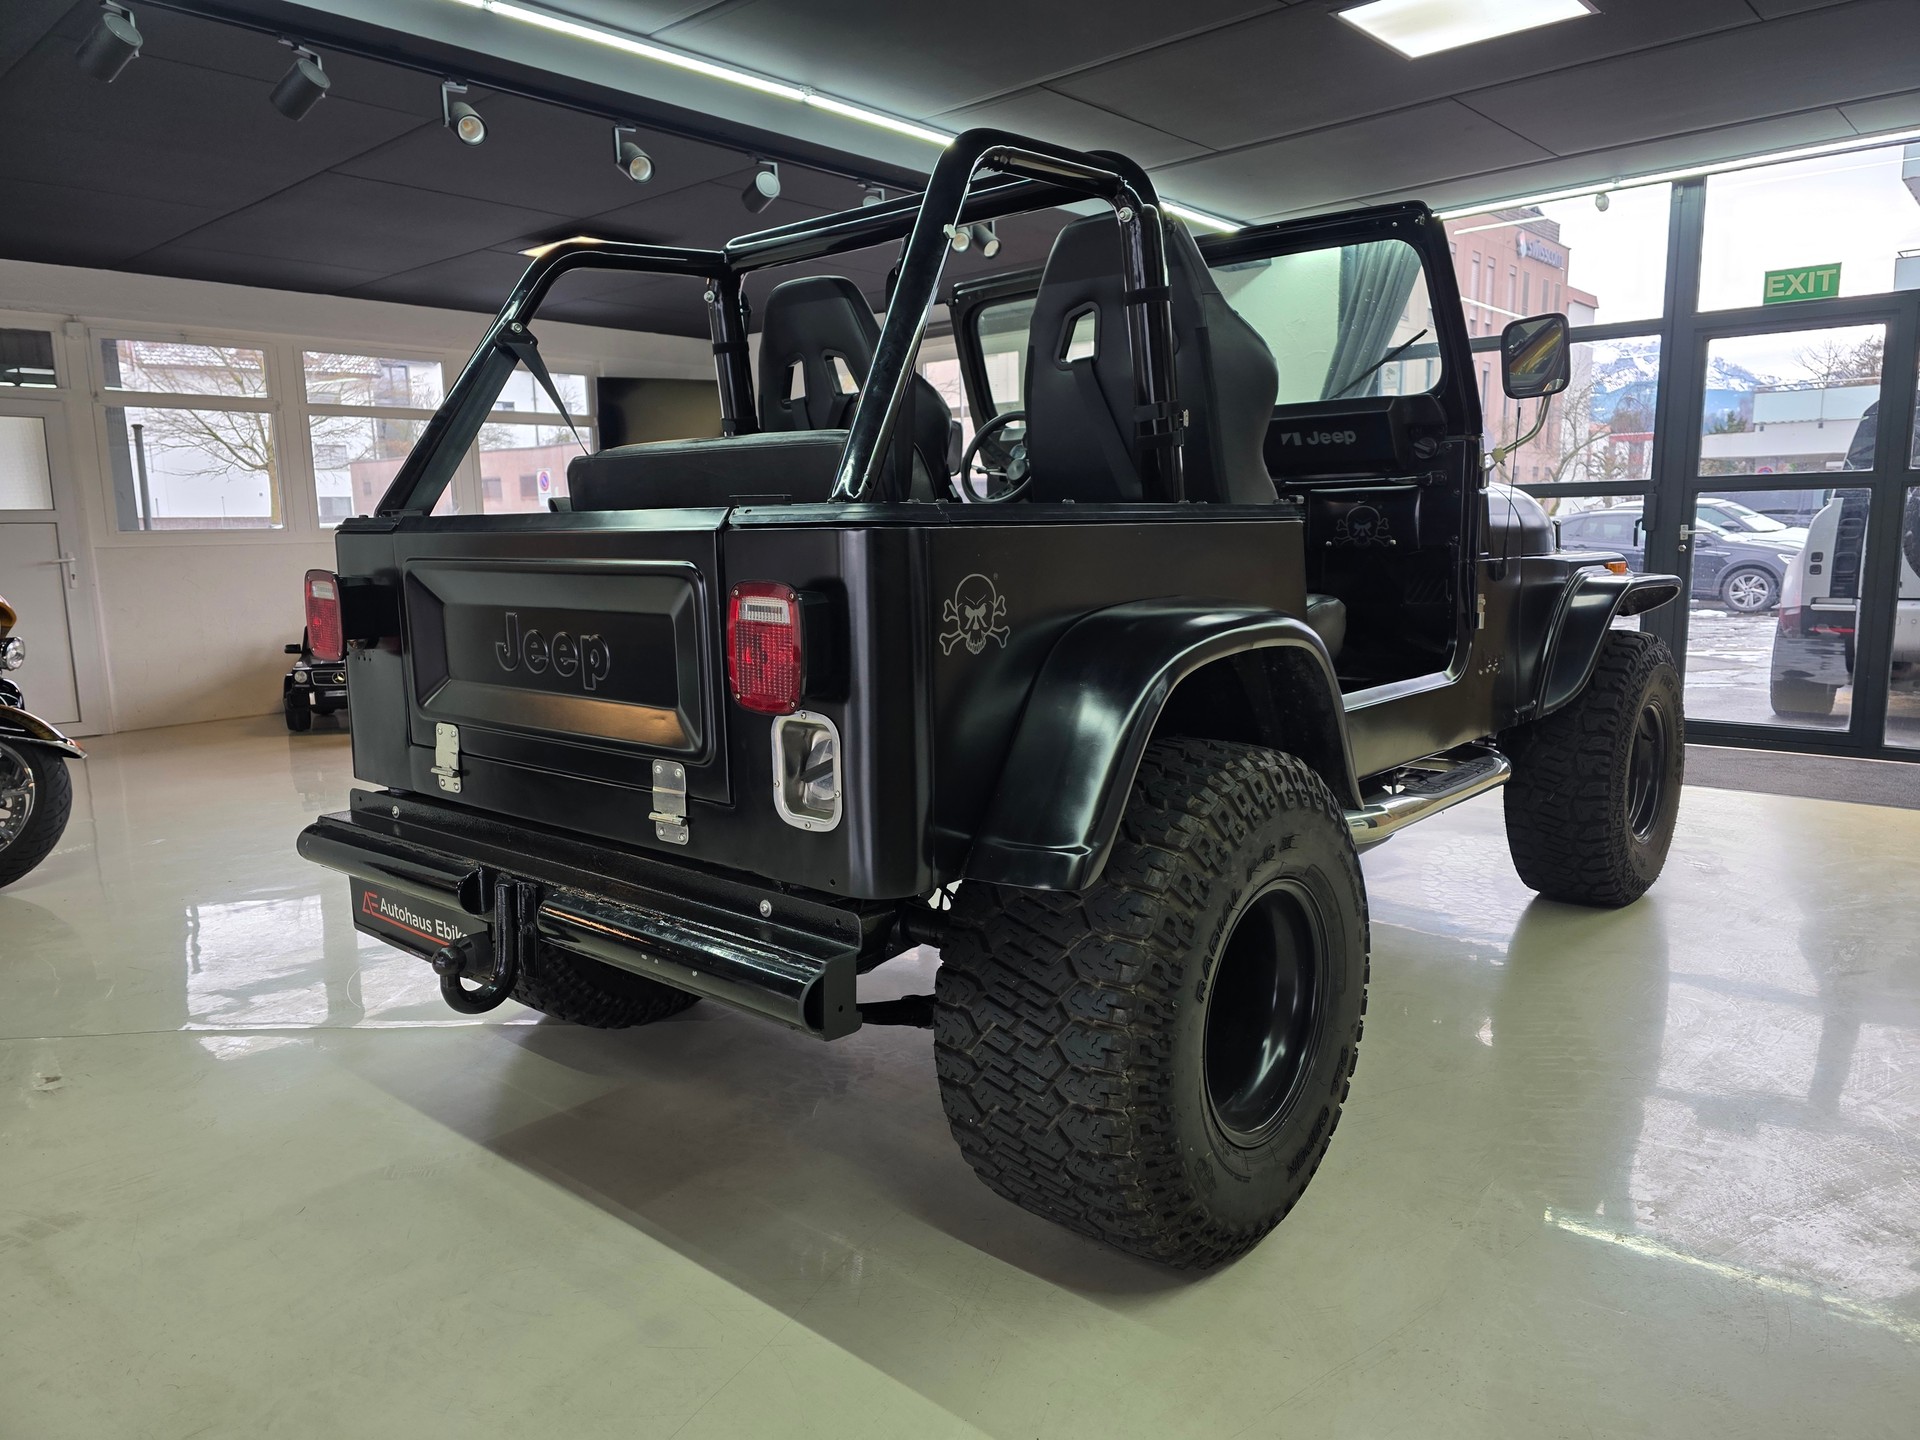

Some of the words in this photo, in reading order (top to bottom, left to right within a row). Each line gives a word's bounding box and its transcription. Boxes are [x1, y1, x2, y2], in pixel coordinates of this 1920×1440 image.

[1766, 268, 1837, 298] EXIT
[1306, 430, 1357, 446] Jeep
[495, 611, 611, 691] Jeep
[380, 897, 433, 933] Autohaus
[1196, 888, 1242, 1004] RADIAL
